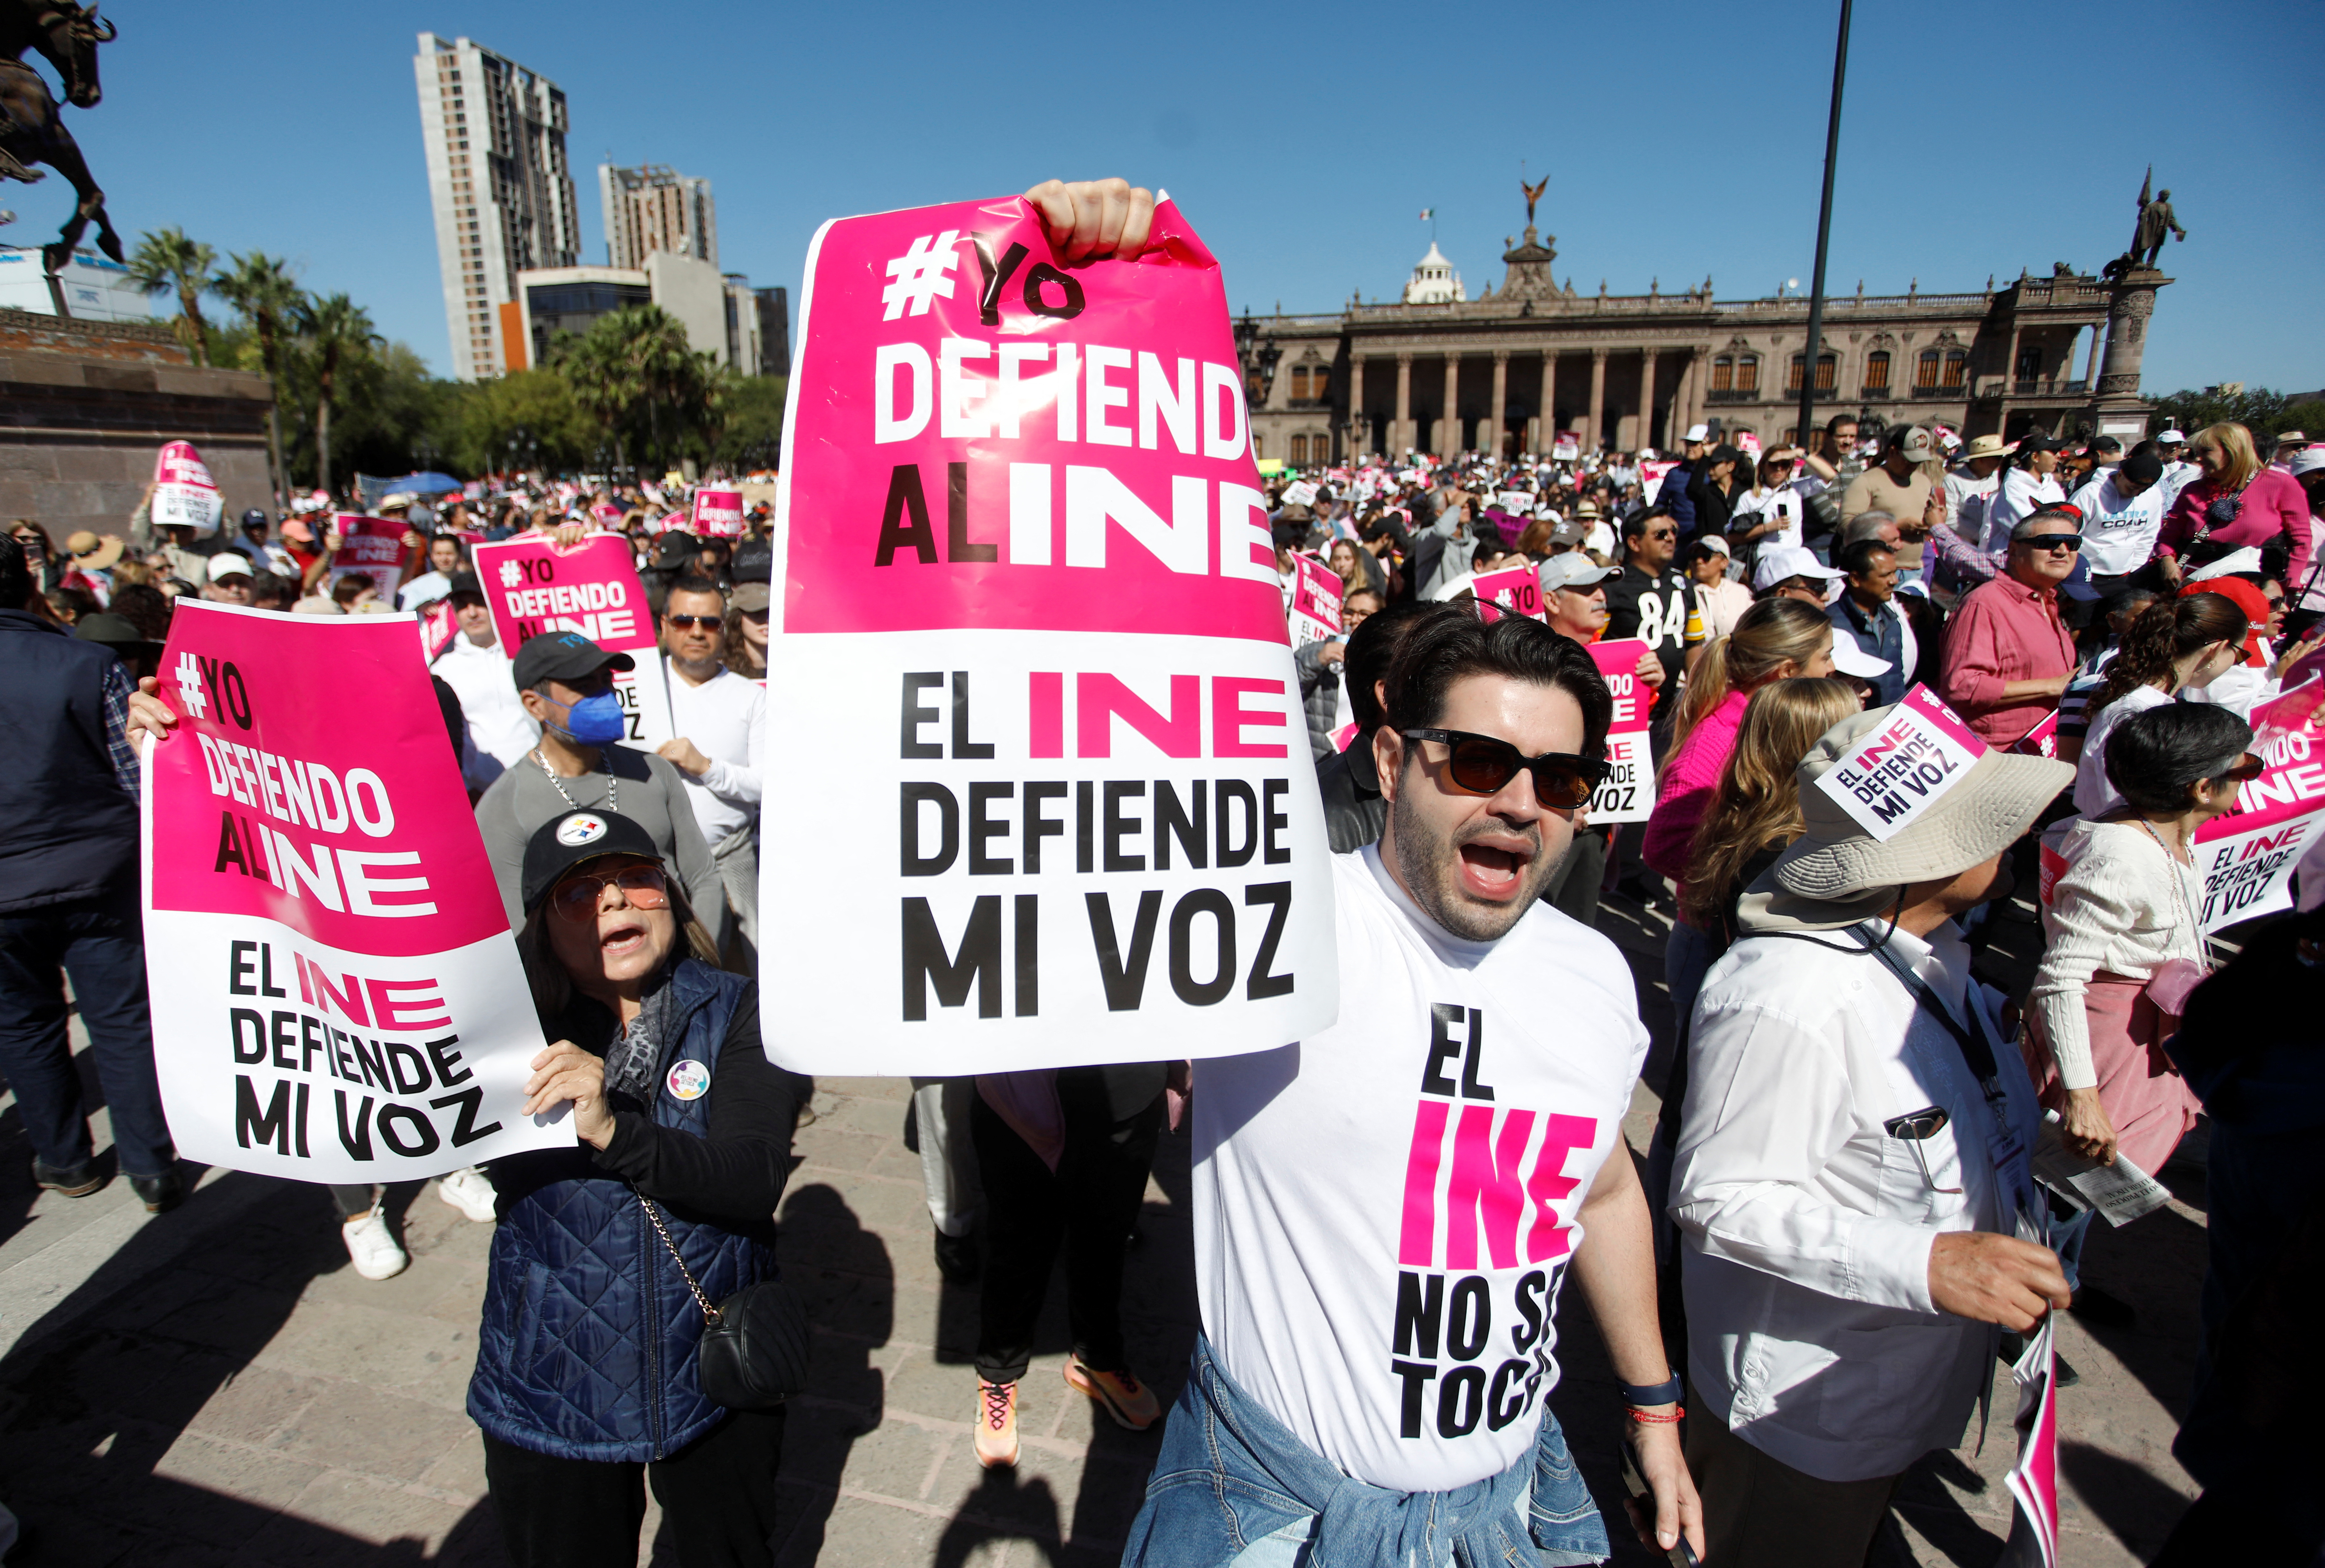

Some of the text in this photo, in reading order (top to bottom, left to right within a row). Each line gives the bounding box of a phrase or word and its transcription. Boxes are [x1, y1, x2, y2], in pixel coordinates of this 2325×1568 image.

[874, 337, 1259, 473] DEFIEND
[698, 507, 740, 521] DEFIENDO
[2100, 517, 2148, 529] COAH
[499, 558, 554, 588] #YO
[505, 581, 626, 618] DEFIENDO
[1303, 575, 1340, 612] DEFIENDO
[558, 634, 592, 648] T9
[1302, 620, 1328, 639] EL IN
[1636, 590, 1685, 651] 84
[175, 651, 252, 730] #YO
[900, 671, 1288, 759] EL INE
[196, 731, 395, 838] DEFIENDO
[1836, 717, 1915, 790] EL INE
[1852, 732, 1935, 805] DEFIENDE
[1870, 748, 1959, 825] MI VOZ
[900, 779, 1291, 877] DEFIENDE
[1590, 786, 1636, 813] VOZ
[2211, 820, 2311, 871] EL INE
[2221, 870, 2276, 916] VOZ
[230, 940, 452, 1031] EL INE
[901, 881, 1294, 1022] MI VOZ
[230, 1007, 474, 1094] DEFIENDE
[1420, 1002, 1495, 1101] EL
[236, 1074, 503, 1161] MI VOZ
[1398, 1099, 1598, 1270] INE
[2105, 1176, 2153, 1199] ELEGIR FISCAL
[2106, 1191, 2141, 1208] PROCESO
[2140, 1188, 2150, 1196] EL
[1392, 1270, 1491, 1361] NO
